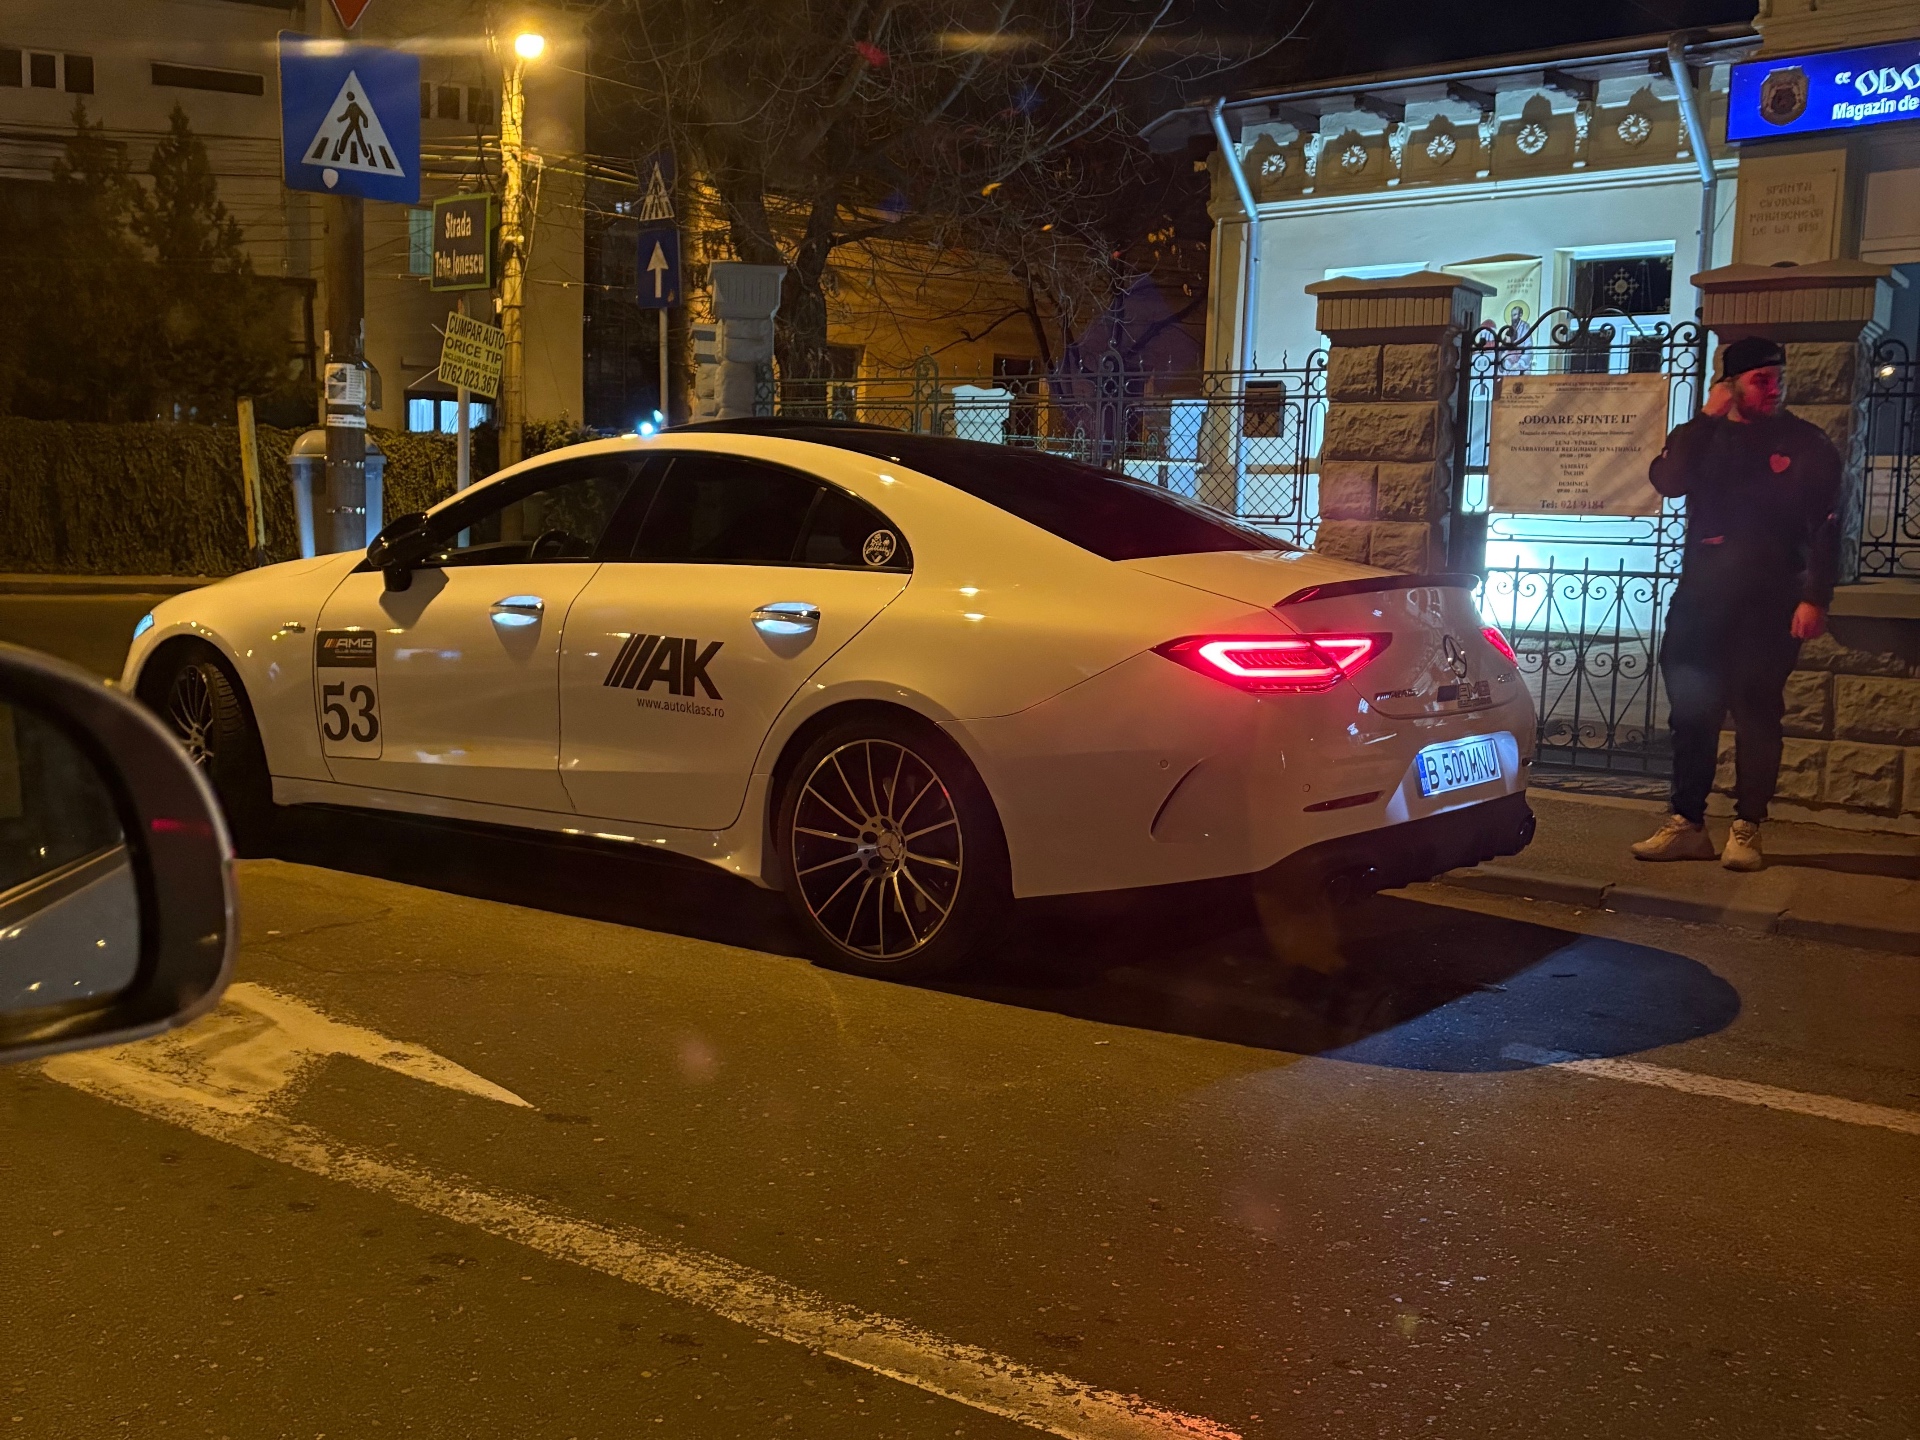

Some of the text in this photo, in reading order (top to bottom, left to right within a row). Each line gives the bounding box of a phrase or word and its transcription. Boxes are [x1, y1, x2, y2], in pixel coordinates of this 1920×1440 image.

[1832, 94, 1920, 121] Magazin de
[445, 210, 472, 239] Strada
[452, 249, 484, 277] Ionescu
[448, 315, 506, 350] CUMPAR AUTO
[445, 336, 503, 365] ORICE TIP
[440, 361, 498, 395] 0762.023.367
[1577, 414, 1619, 425] SFINTE
[335, 638, 373, 649] AMG
[323, 681, 379, 742] 53
[636, 697, 725, 718] www.autoklass.ro
[1425, 756, 1440, 790] B
